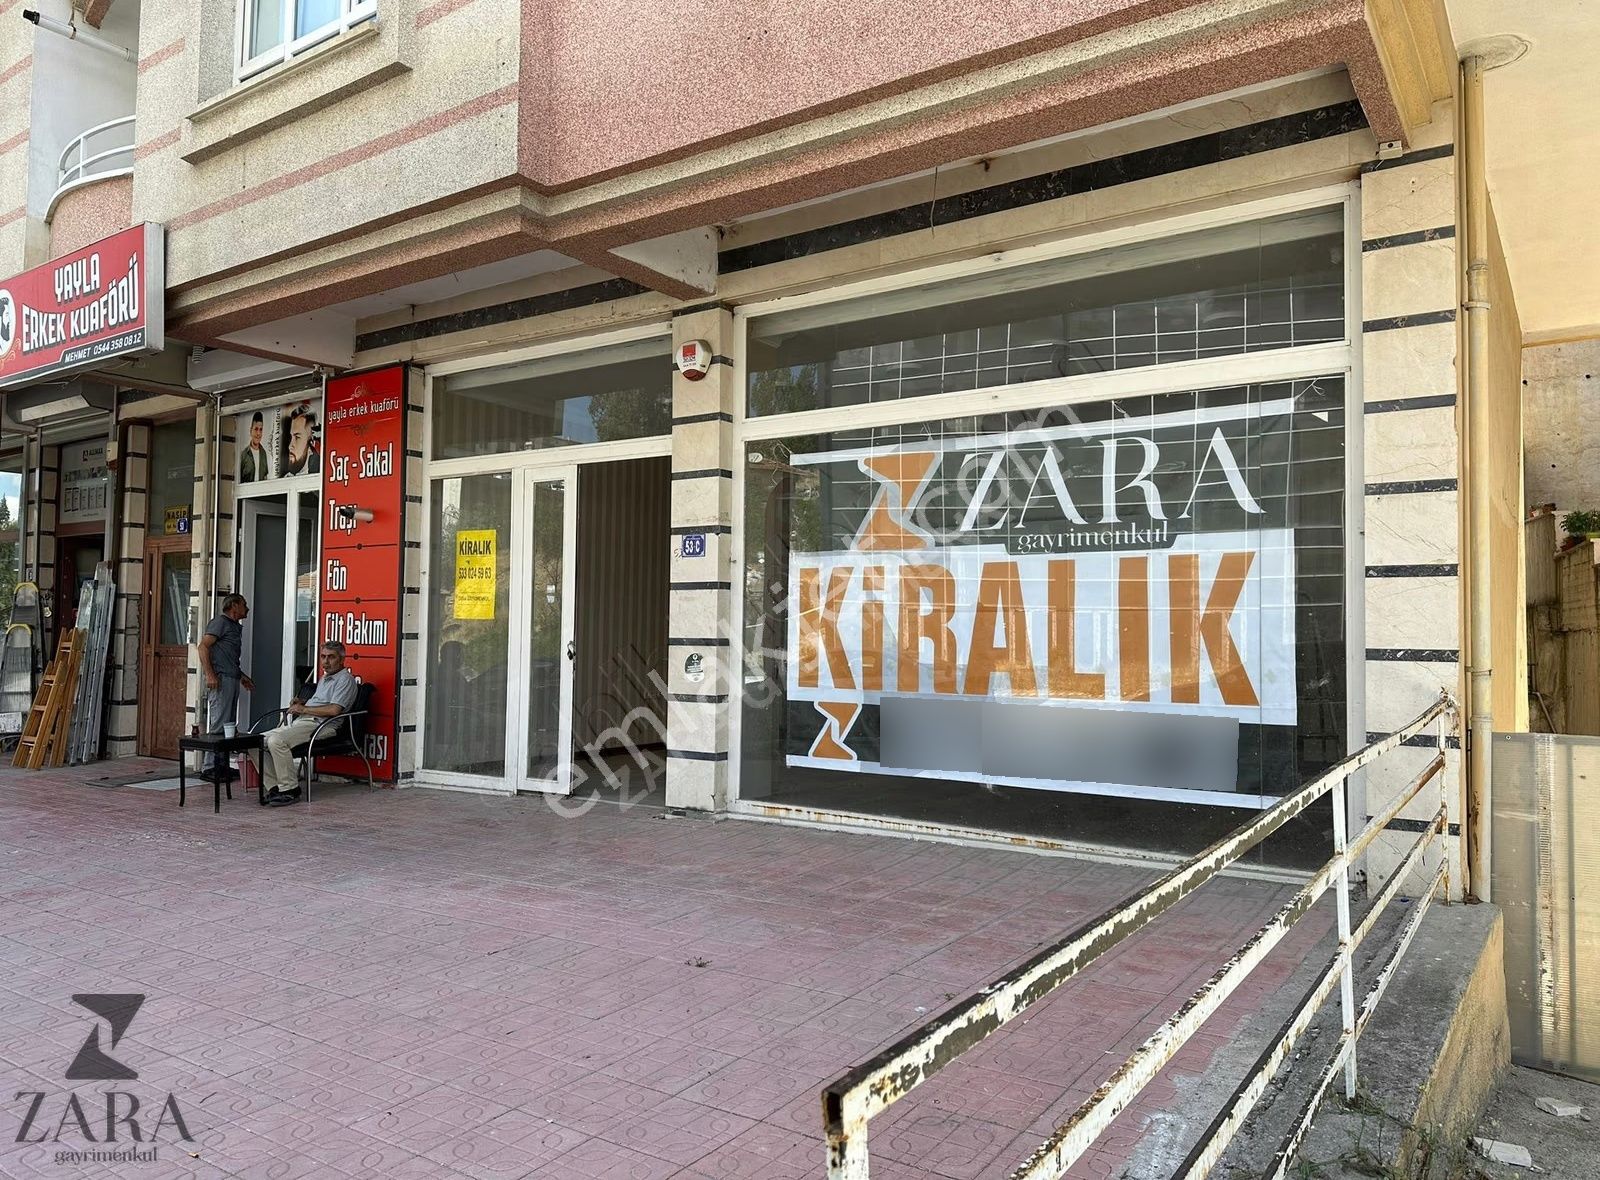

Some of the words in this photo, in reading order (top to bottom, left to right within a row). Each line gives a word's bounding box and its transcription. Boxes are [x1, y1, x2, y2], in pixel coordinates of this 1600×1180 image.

[54, 252, 100, 302] YAYLA
[22, 303, 67, 353] ERKEK
[70, 251, 139, 338] KUAFÖRÜ
[65, 347, 92, 363] MEHMET
[93, 341, 110, 355] 0544
[110, 337, 123, 351] 358
[124, 334, 133, 347] 08
[133, 332, 142, 344] 12
[328, 406, 347, 425] yayla
[349, 402, 369, 417] erkek
[370, 397, 399, 414] kuaförü
[329, 450, 349, 487] Saç
[359, 442, 393, 479] Sakal
[959, 426, 1267, 532] ZARA
[459, 538, 491, 555] KİRALIK
[685, 541, 693, 553] 53
[696, 541, 700, 553] C
[1017, 520, 1169, 555] gayrimenkul
[326, 559, 347, 591] Fön
[325, 613, 344, 643] Cilt
[346, 612, 388, 646] Bakımı
